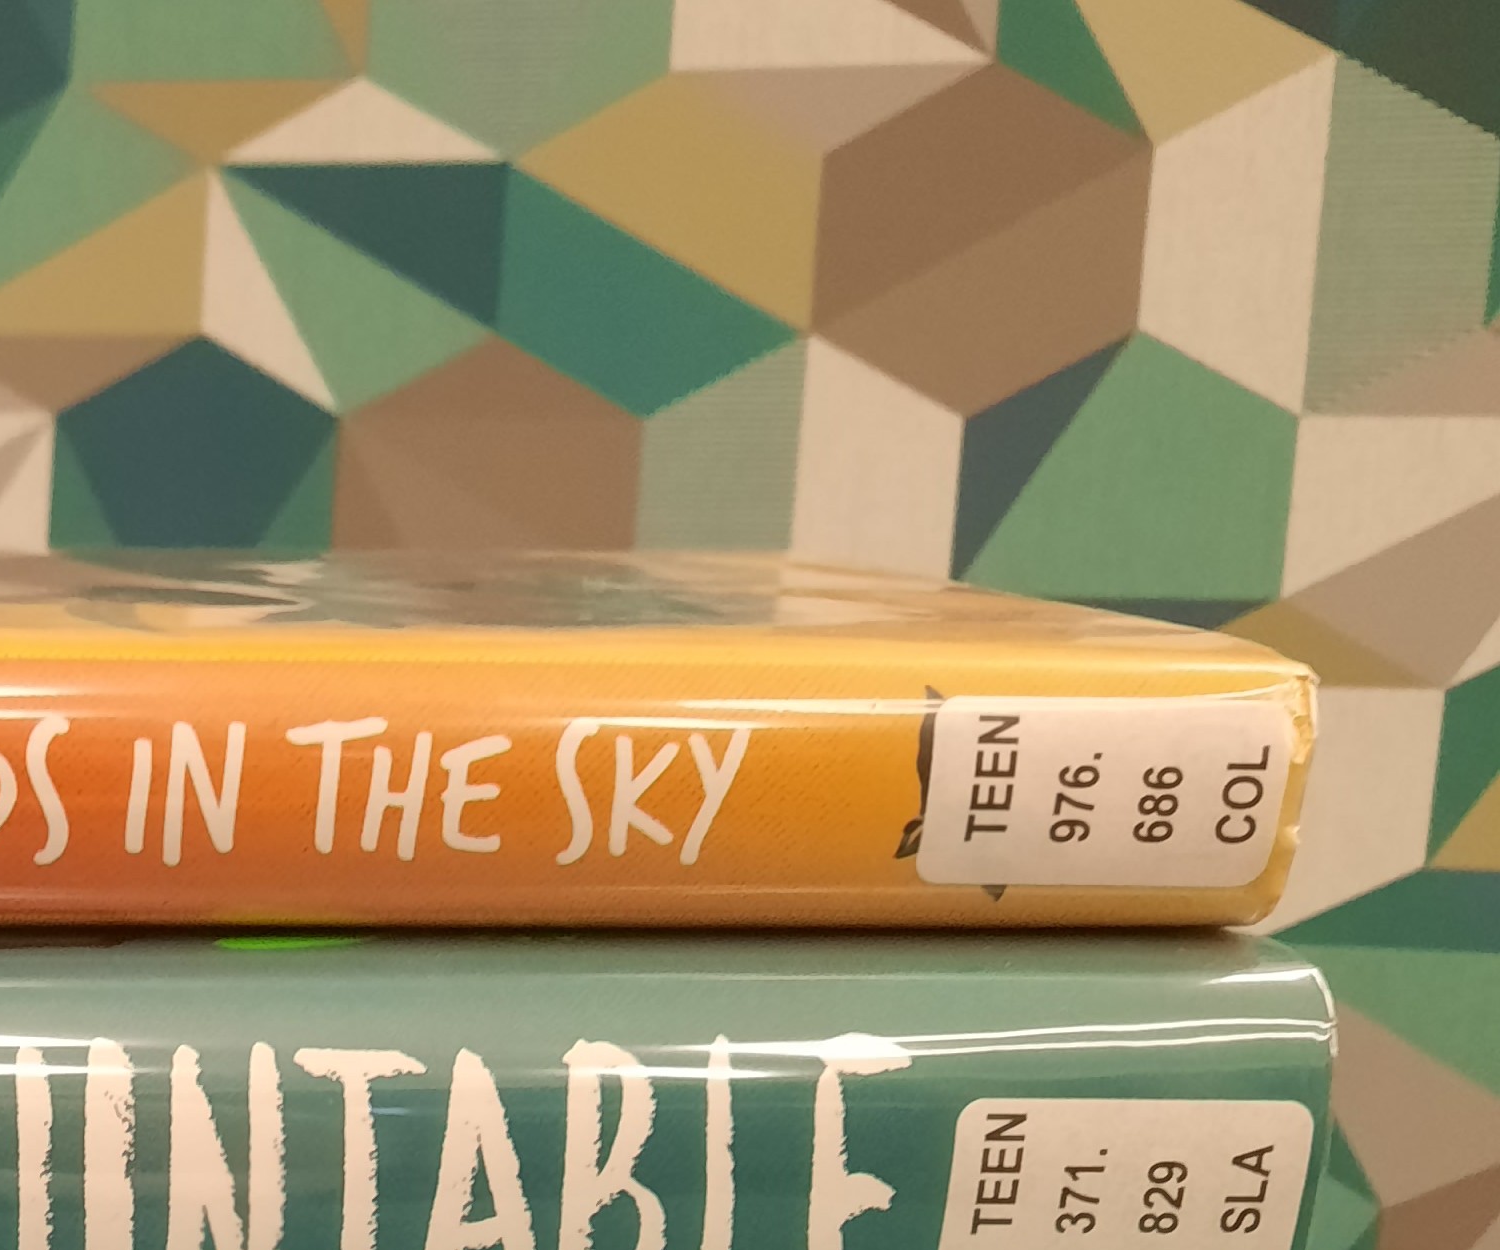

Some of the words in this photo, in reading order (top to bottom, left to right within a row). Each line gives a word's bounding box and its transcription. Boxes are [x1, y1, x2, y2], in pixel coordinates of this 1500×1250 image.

[124, 720, 247, 867] IN
[285, 717, 513, 862] THE
[555, 717, 755, 866] SKY
[963, 715, 1021, 843] TEEN
[1049, 752, 1103, 844] 976.
[1132, 765, 1183, 844] 686
[1215, 745, 1271, 845] COL
[970, 1113, 1028, 1236] TEEN
[1055, 1148, 1108, 1235] 371.
[1139, 1160, 1188, 1235] 829
[1220, 1145, 1274, 1234] SLA
